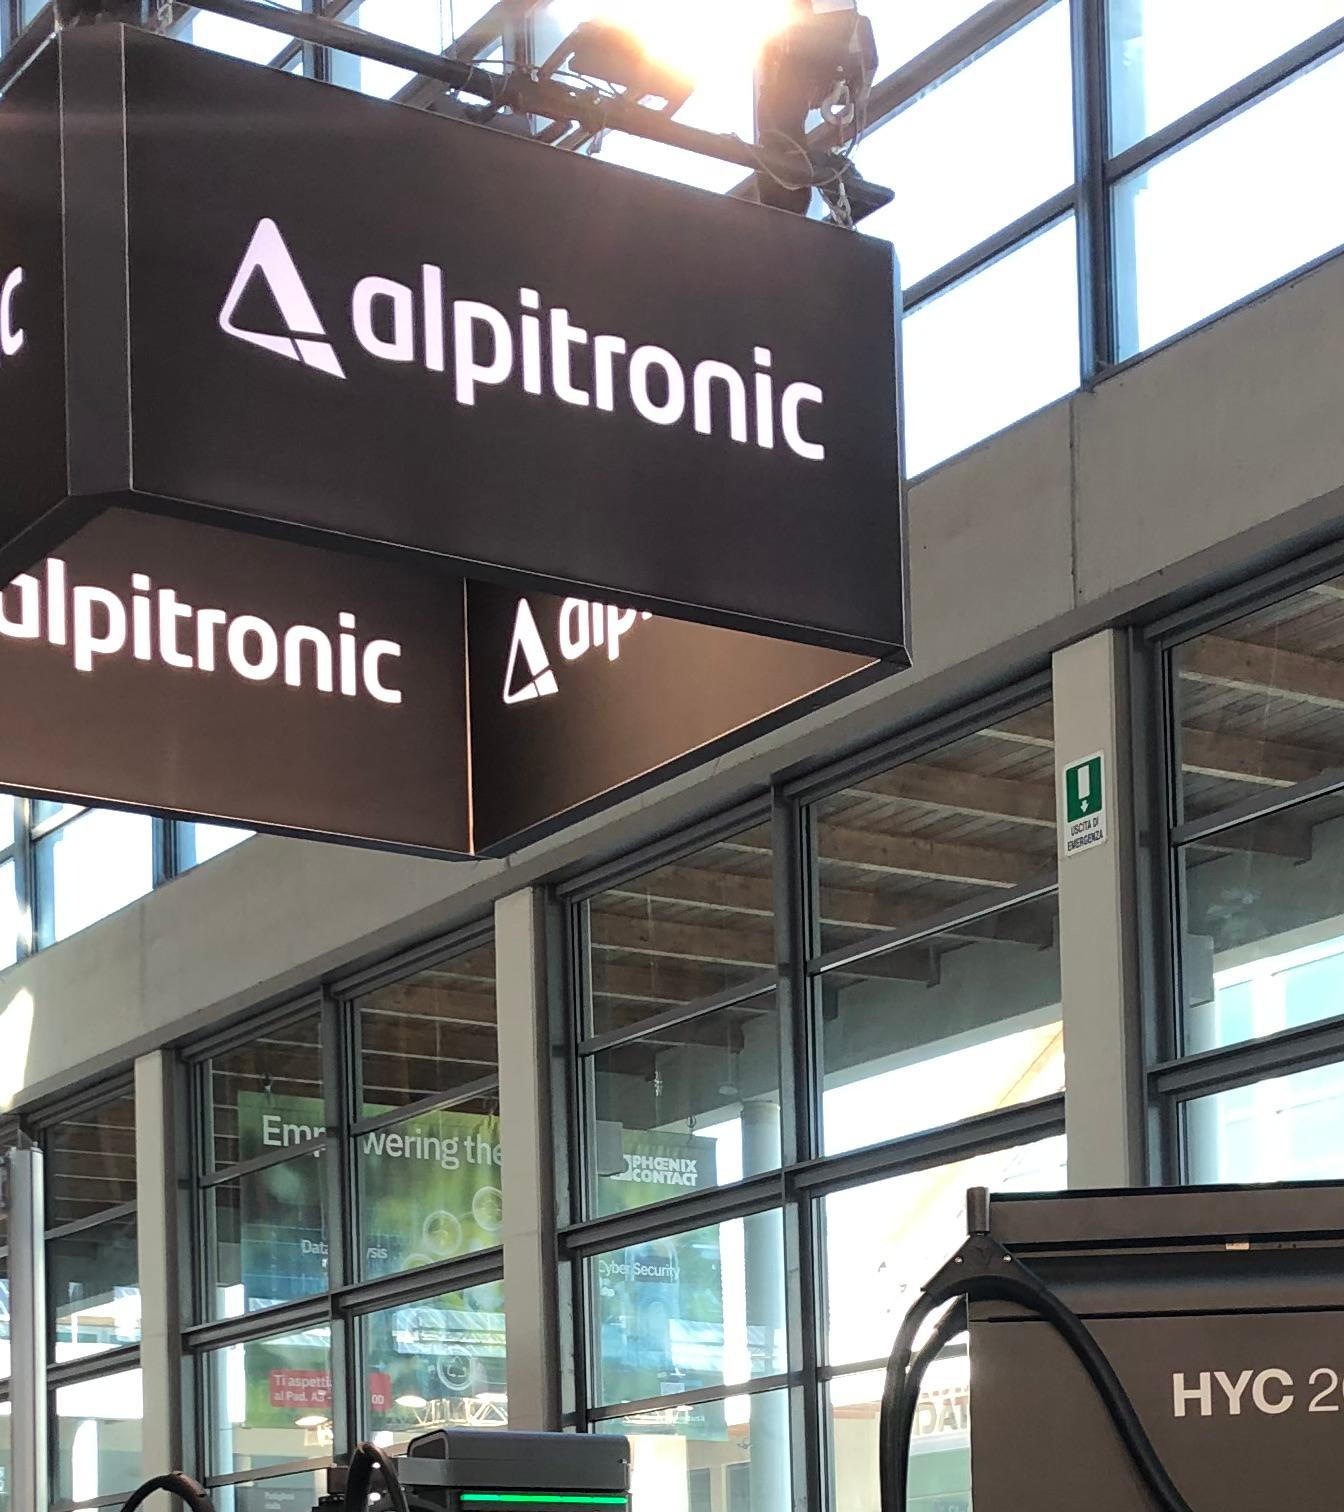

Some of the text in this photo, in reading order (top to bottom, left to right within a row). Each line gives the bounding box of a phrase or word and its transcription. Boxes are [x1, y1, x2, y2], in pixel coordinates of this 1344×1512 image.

[350, 262, 825, 462] alpitronic
[1070, 815, 1099, 837] USCITA DI
[1067, 829, 1104, 851] EMERGENZA
[632, 1168, 698, 1187] CONTACT
[598, 1259, 680, 1279] Cyber Security
[1172, 1367, 1295, 1418] HYC
